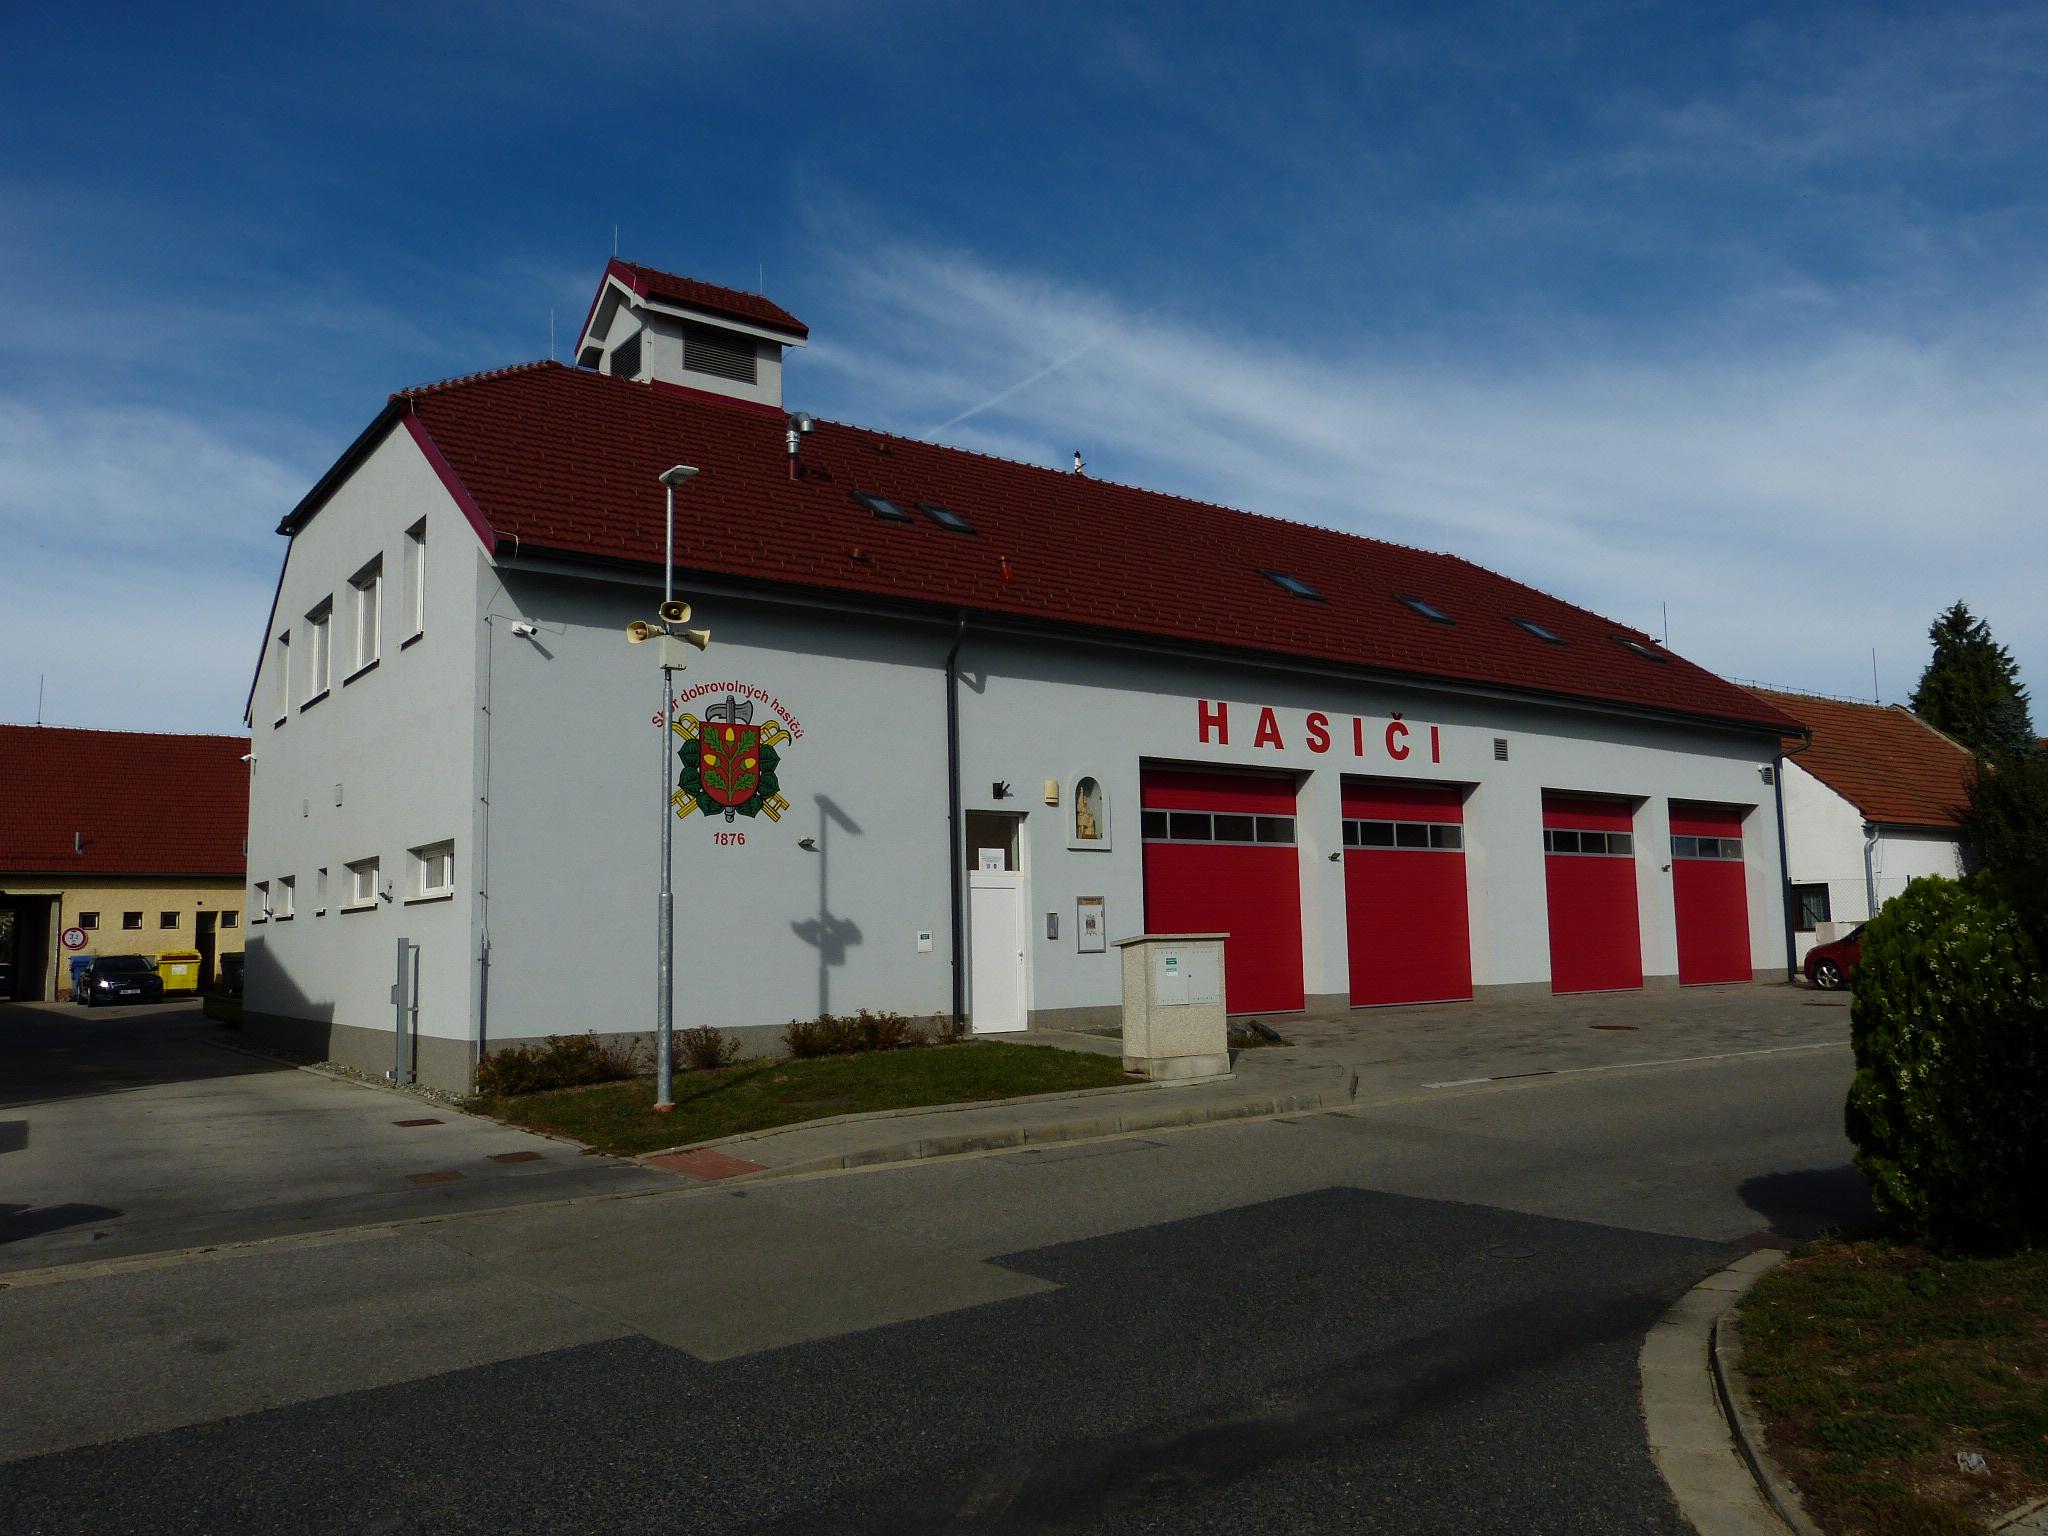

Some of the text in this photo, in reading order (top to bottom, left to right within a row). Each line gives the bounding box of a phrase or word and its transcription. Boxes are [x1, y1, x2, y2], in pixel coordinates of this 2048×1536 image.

[681, 680, 769, 703] dobrovolných
[770, 698, 804, 739] hasičů
[1198, 699, 1440, 763] HASIČI
[713, 832, 745, 846] 1876
